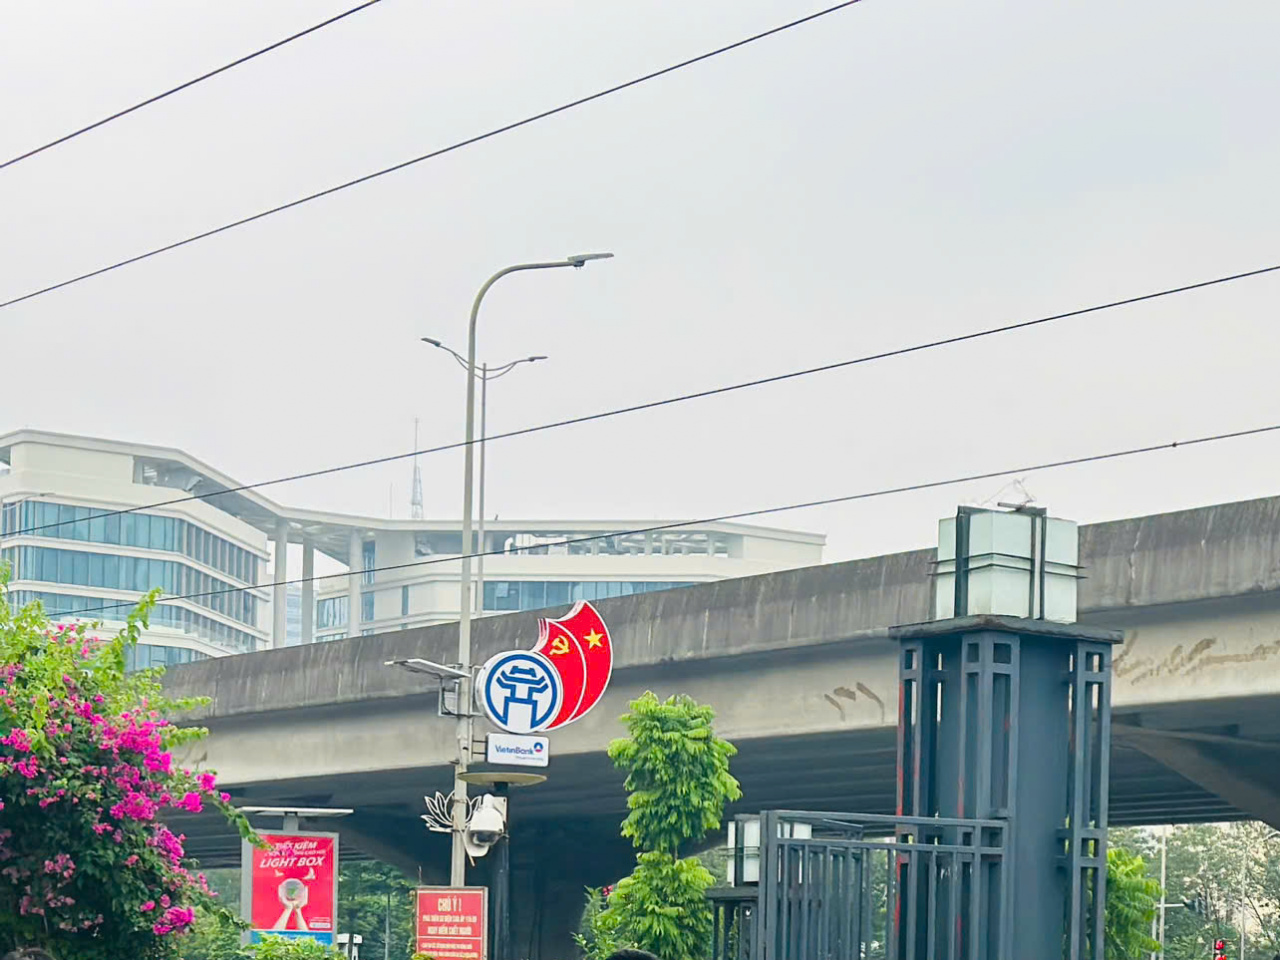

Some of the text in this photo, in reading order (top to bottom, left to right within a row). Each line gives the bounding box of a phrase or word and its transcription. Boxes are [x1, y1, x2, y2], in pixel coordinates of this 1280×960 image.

[495, 745, 533, 755] VietinBank
[259, 856, 325, 868] LIGHT BOX
